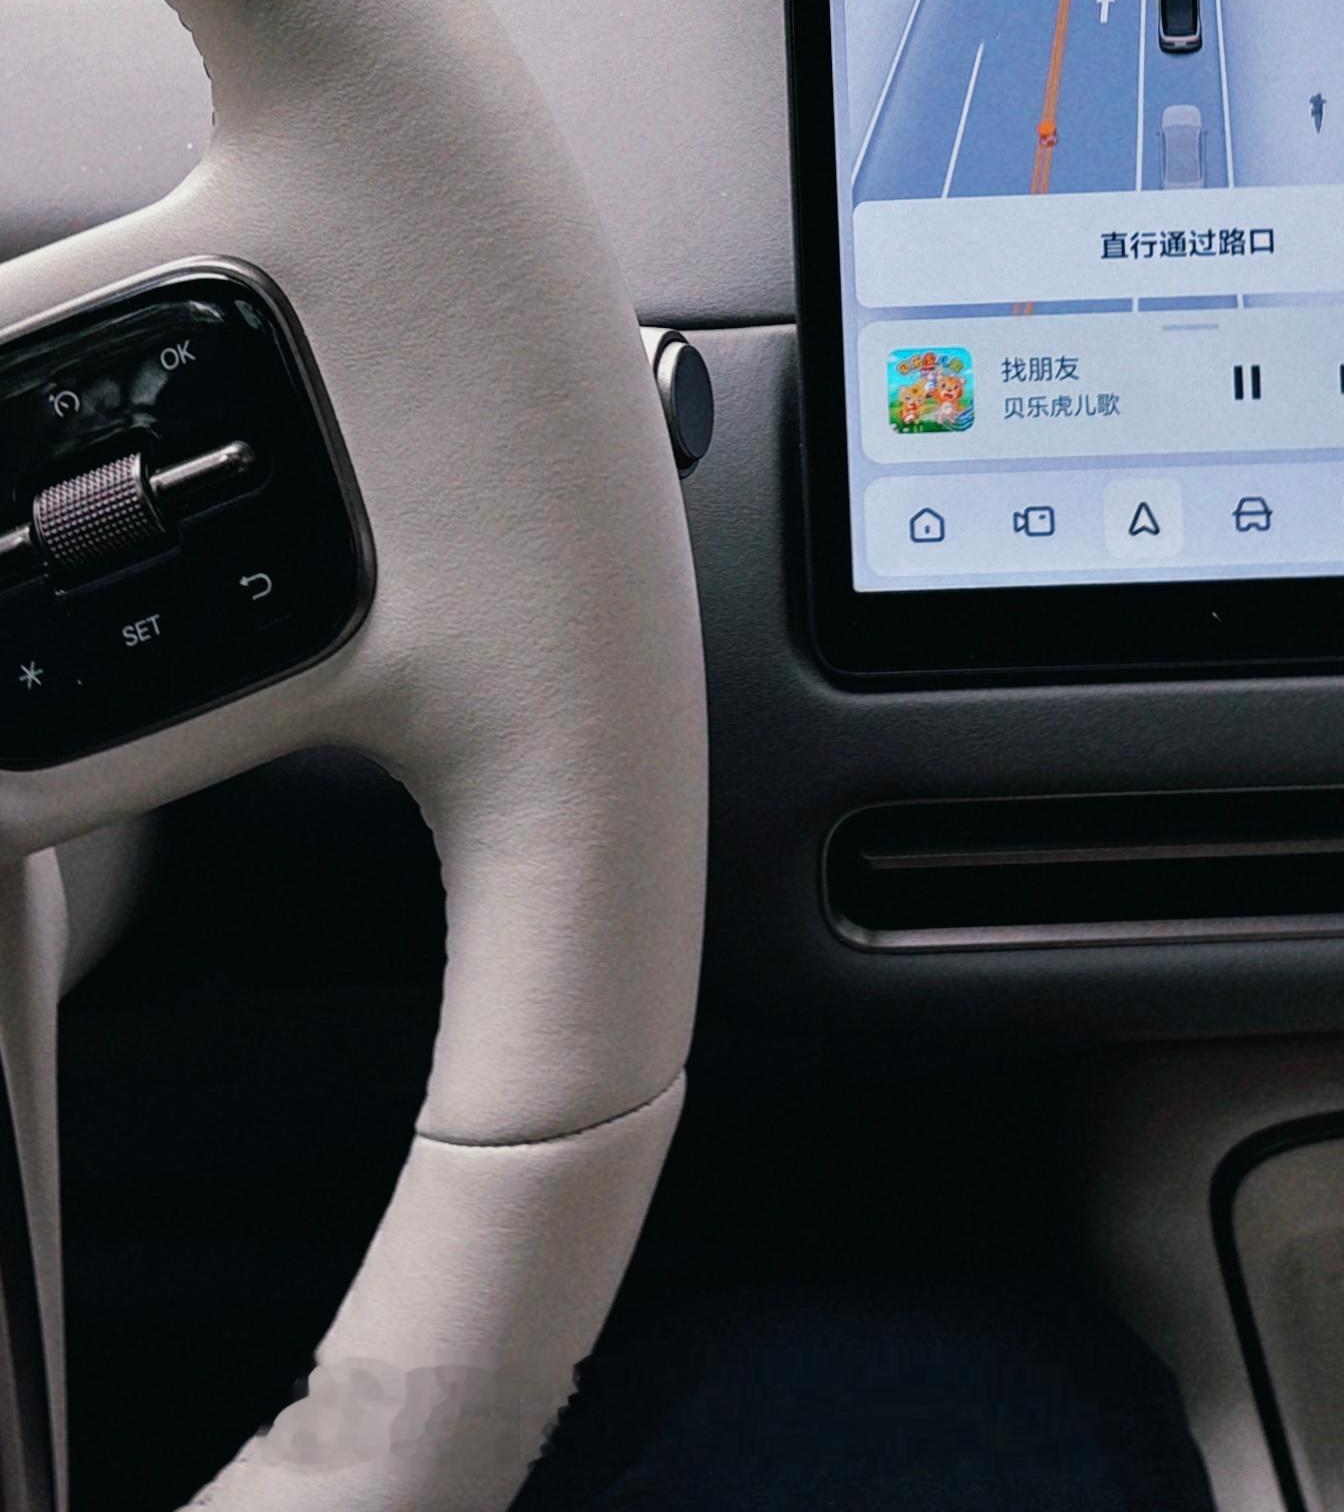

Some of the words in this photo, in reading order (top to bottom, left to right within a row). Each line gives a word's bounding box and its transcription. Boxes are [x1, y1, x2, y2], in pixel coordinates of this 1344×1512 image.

[1100, 227, 1276, 261] 直行通过路口
[160, 340, 196, 372] OK
[1001, 354, 1080, 383] 找朋友
[1002, 391, 1122, 421] 贝乐虎儿歌
[122, 614, 161, 647] SET
